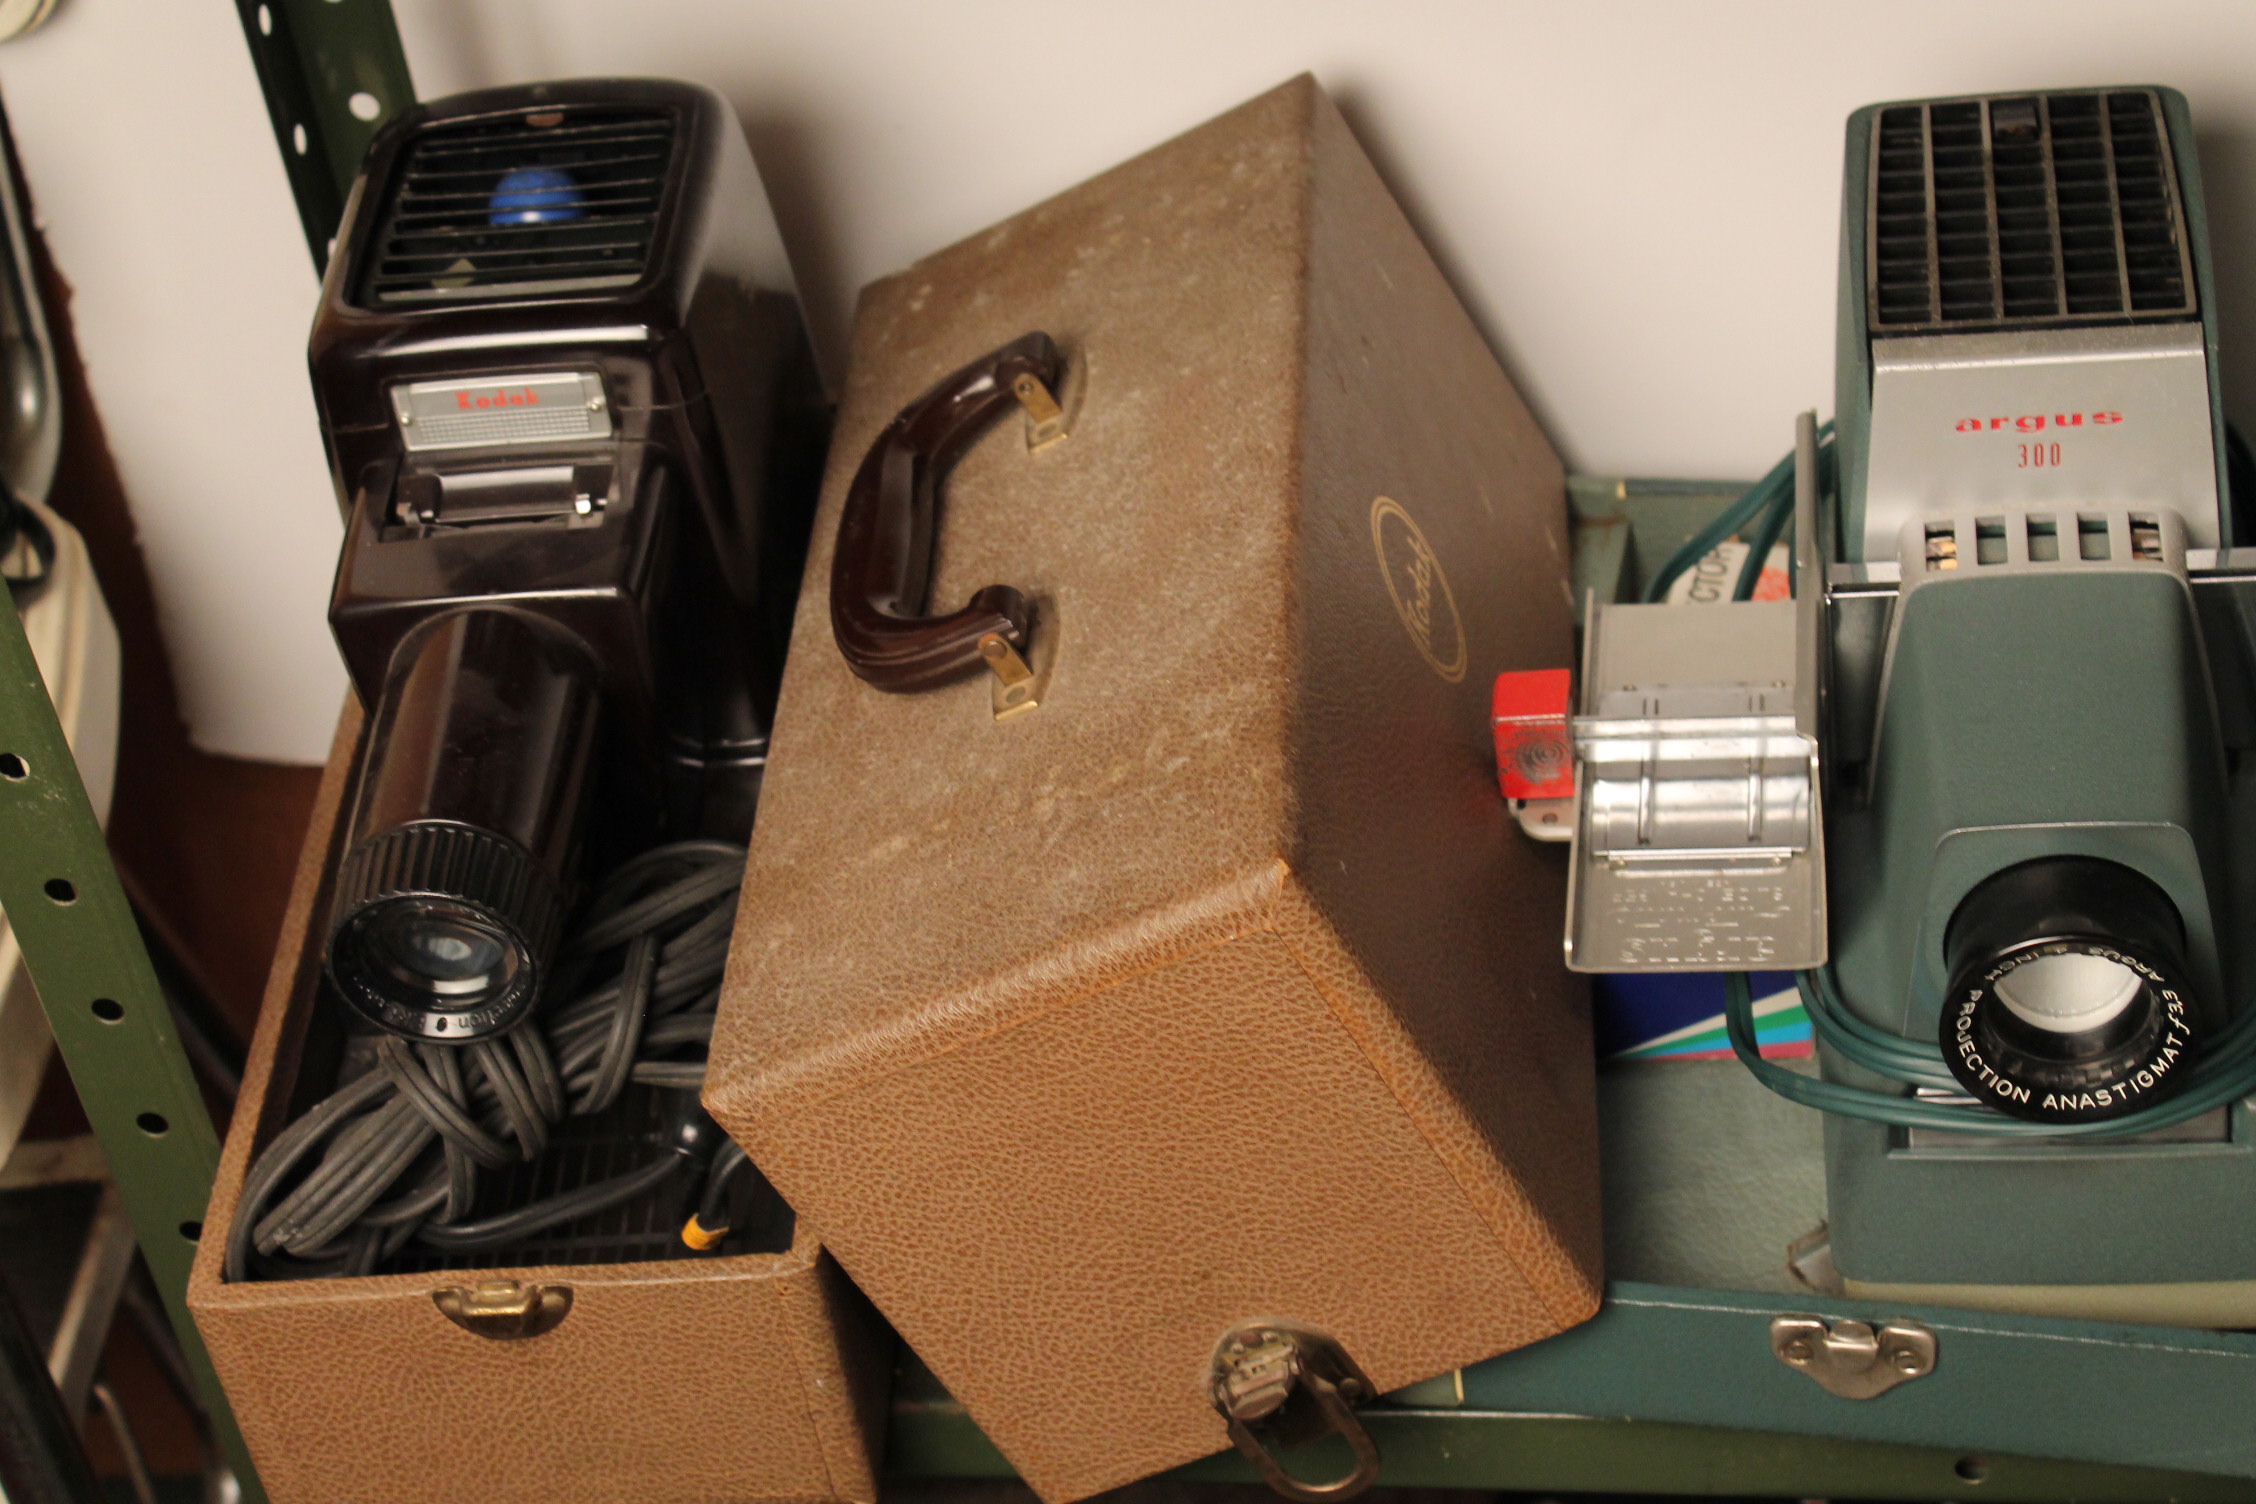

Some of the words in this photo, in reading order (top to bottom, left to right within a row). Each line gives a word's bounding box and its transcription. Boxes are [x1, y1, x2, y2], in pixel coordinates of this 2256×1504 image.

[455, 387, 539, 410] Kodak
[1955, 411, 2124, 433] argus
[2018, 442, 2061, 468] 300
[1406, 535, 1432, 650] Kodak
[2088, 946, 2165, 982] ARGUS
[1955, 988, 2031, 1104] PROJECTION
[2041, 1031, 2184, 1111] ANASTIGMAT
